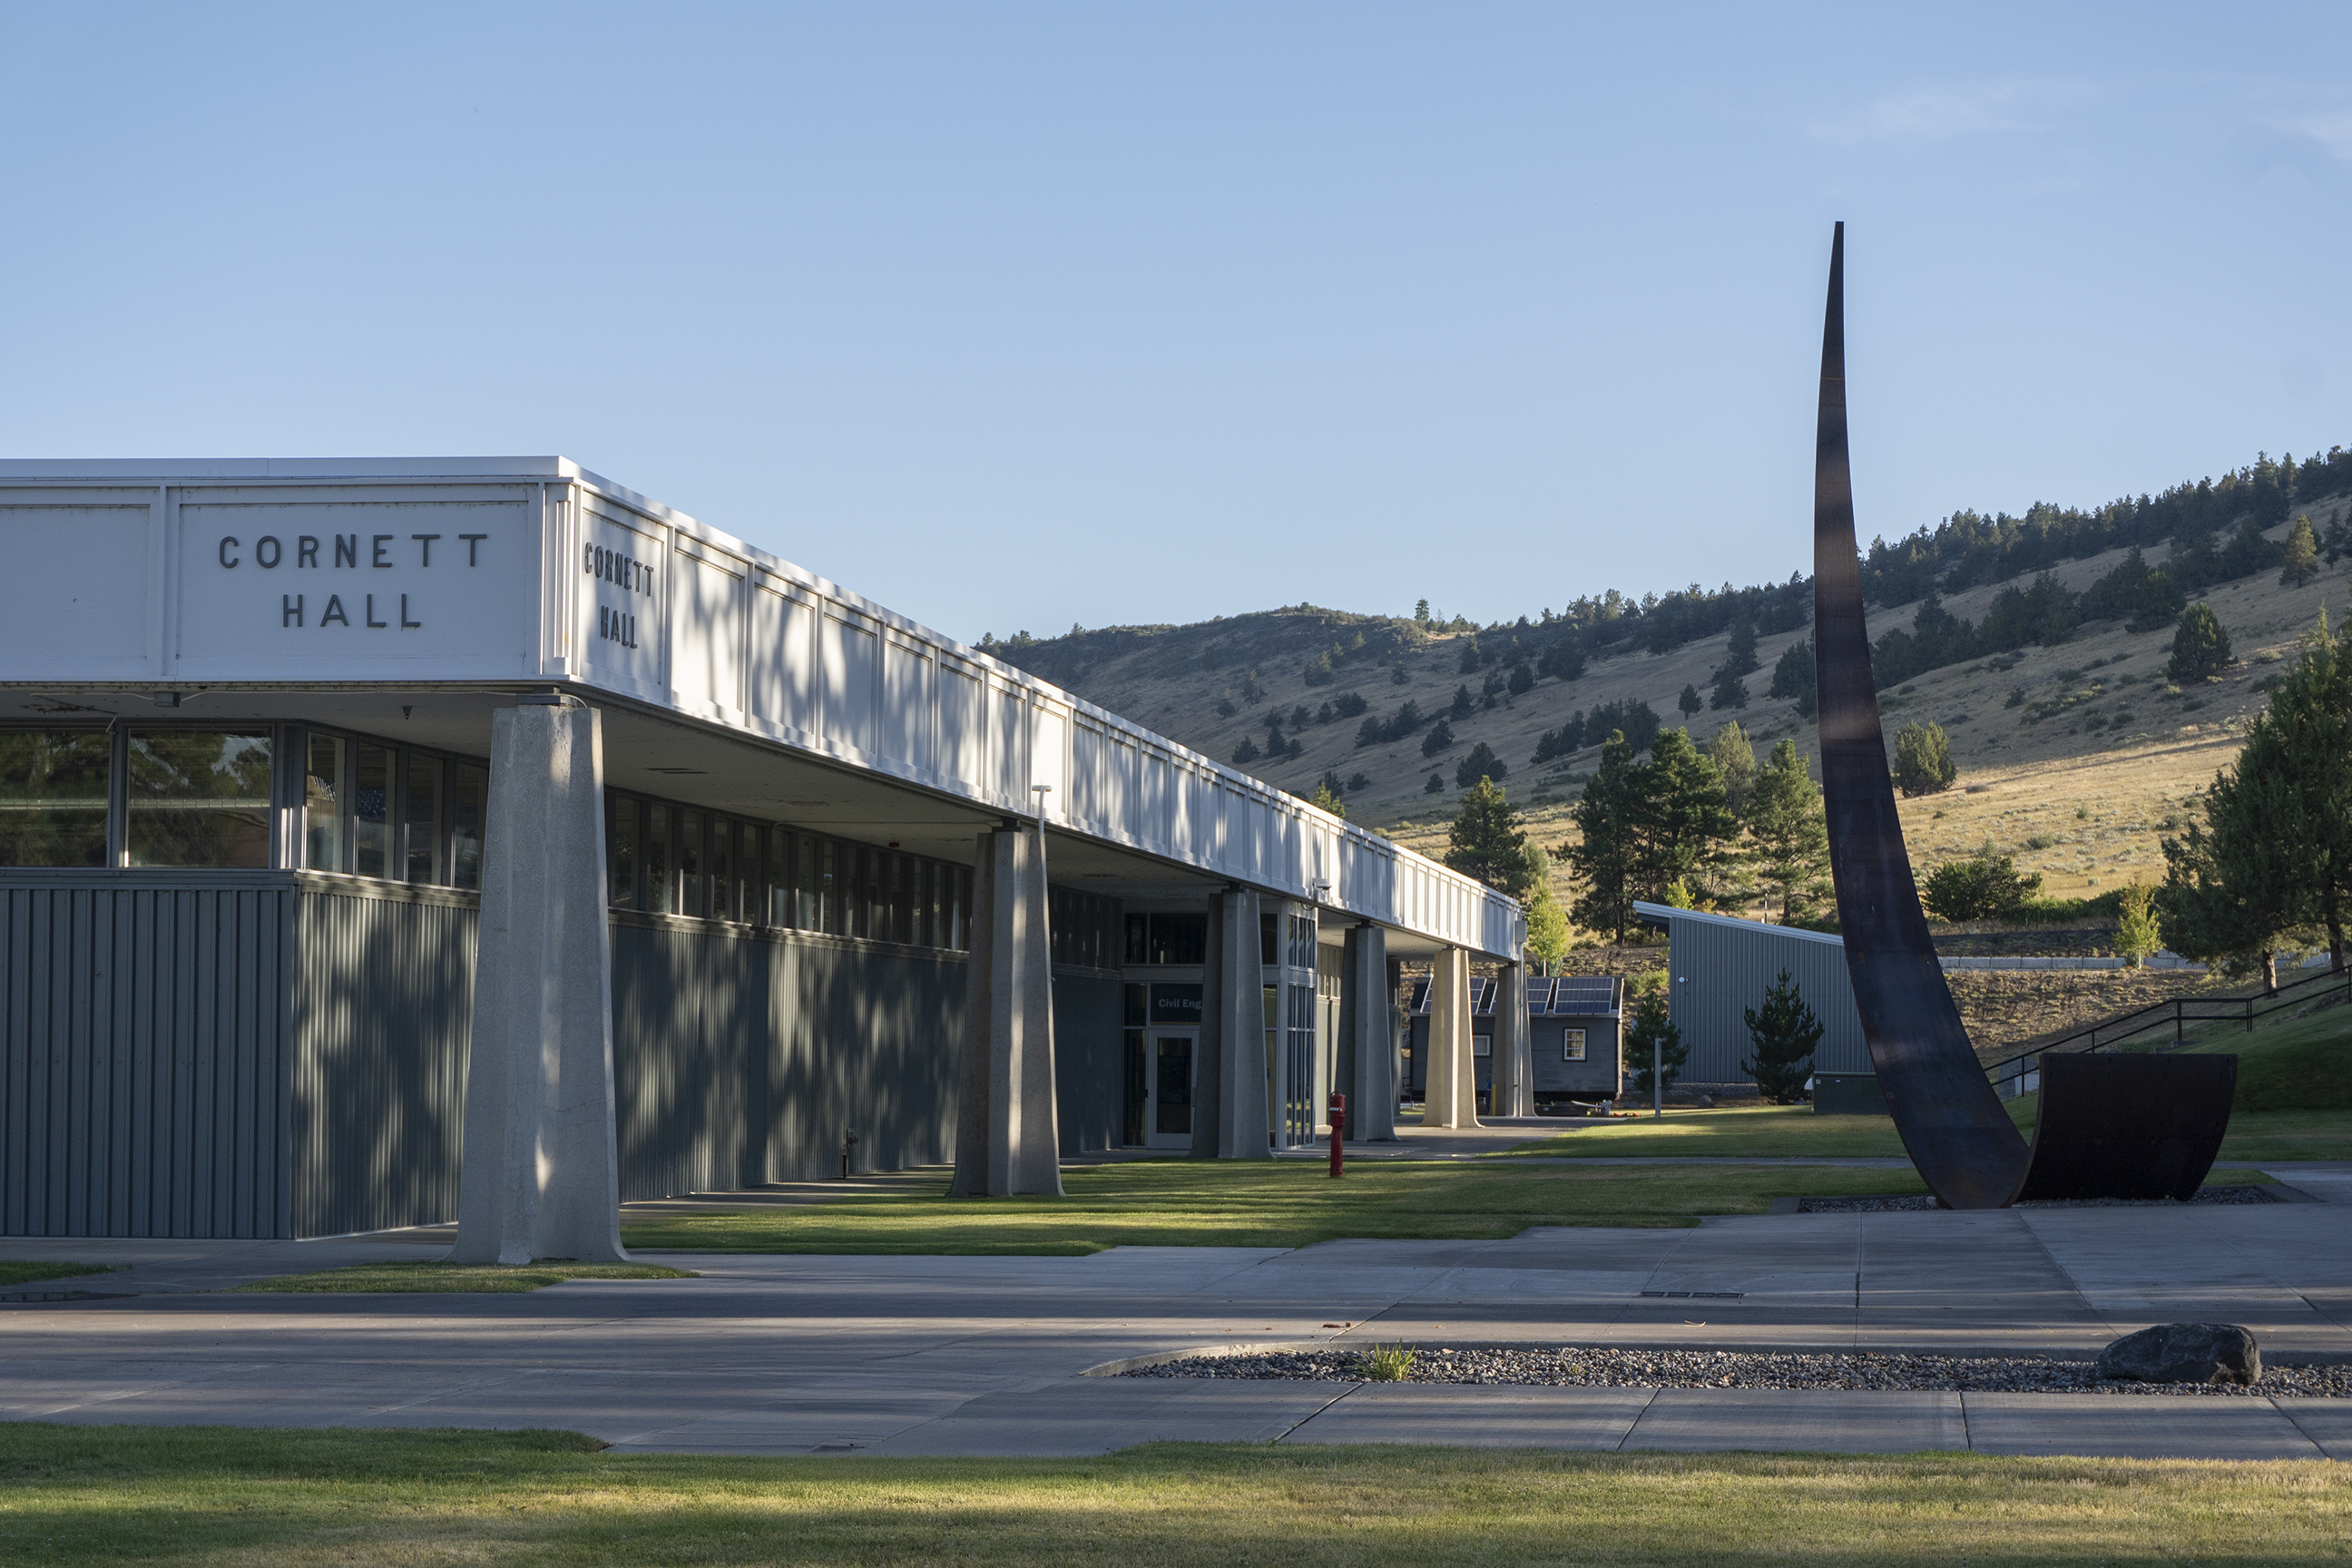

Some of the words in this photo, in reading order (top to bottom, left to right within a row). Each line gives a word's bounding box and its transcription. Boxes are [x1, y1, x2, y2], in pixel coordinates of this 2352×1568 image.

[219, 534, 487, 568] CORNETT
[584, 542, 654, 597] CORNETT
[282, 593, 421, 628] HALL
[600, 605, 638, 649] HALL
[1158, 998, 1180, 1008] Civil
